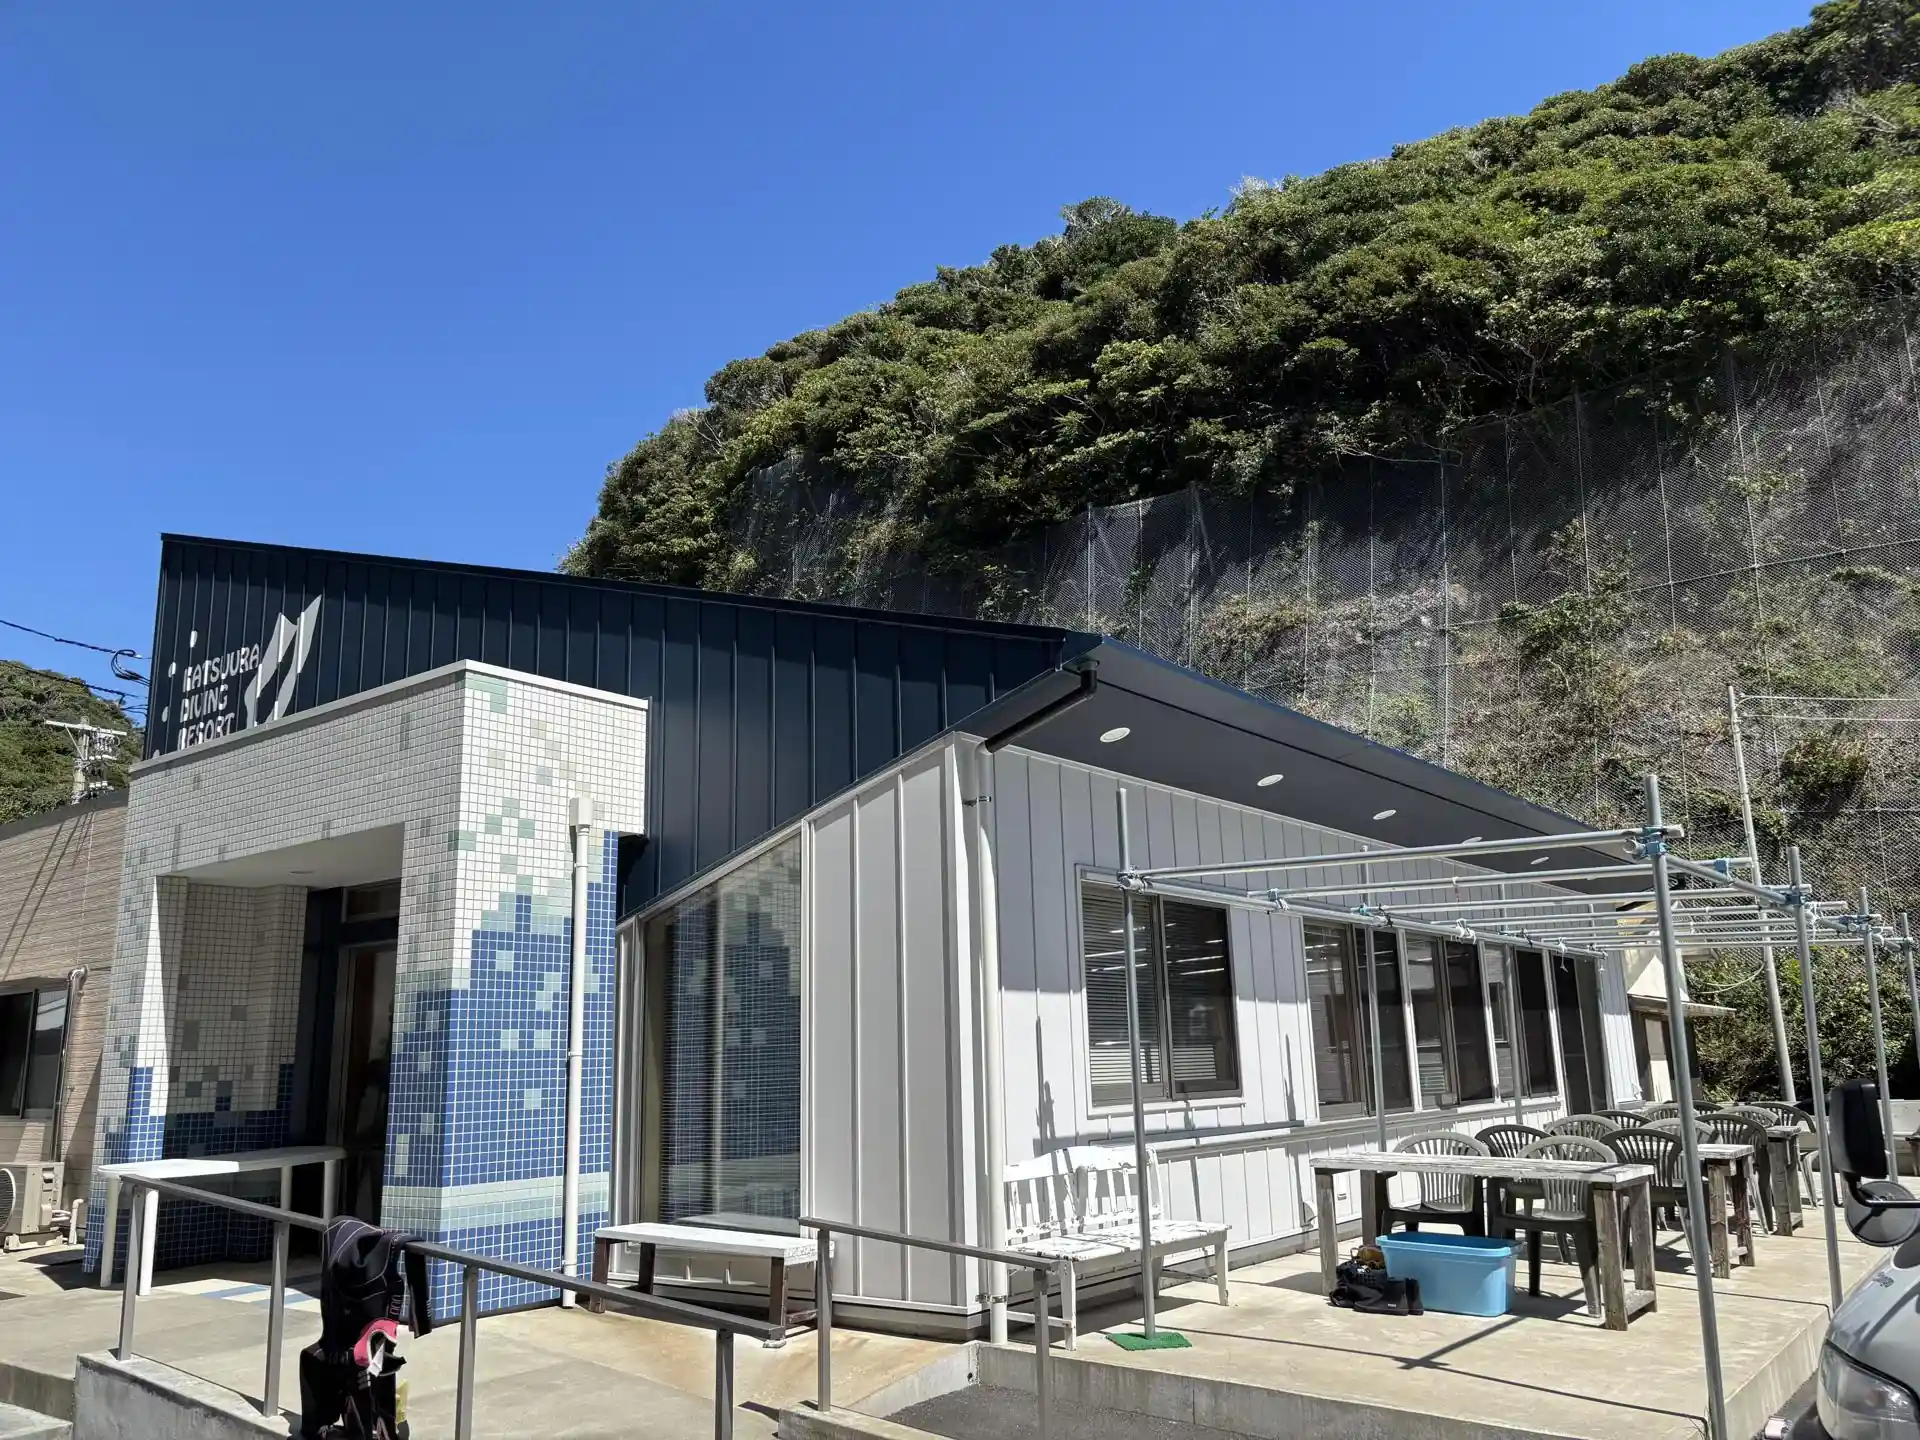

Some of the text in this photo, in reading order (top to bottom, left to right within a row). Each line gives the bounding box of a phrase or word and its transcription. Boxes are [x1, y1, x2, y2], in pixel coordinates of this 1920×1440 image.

[183, 643, 260, 692] KATSUURA
[180, 684, 228, 723] DIVING
[177, 712, 235, 750] RESORT
